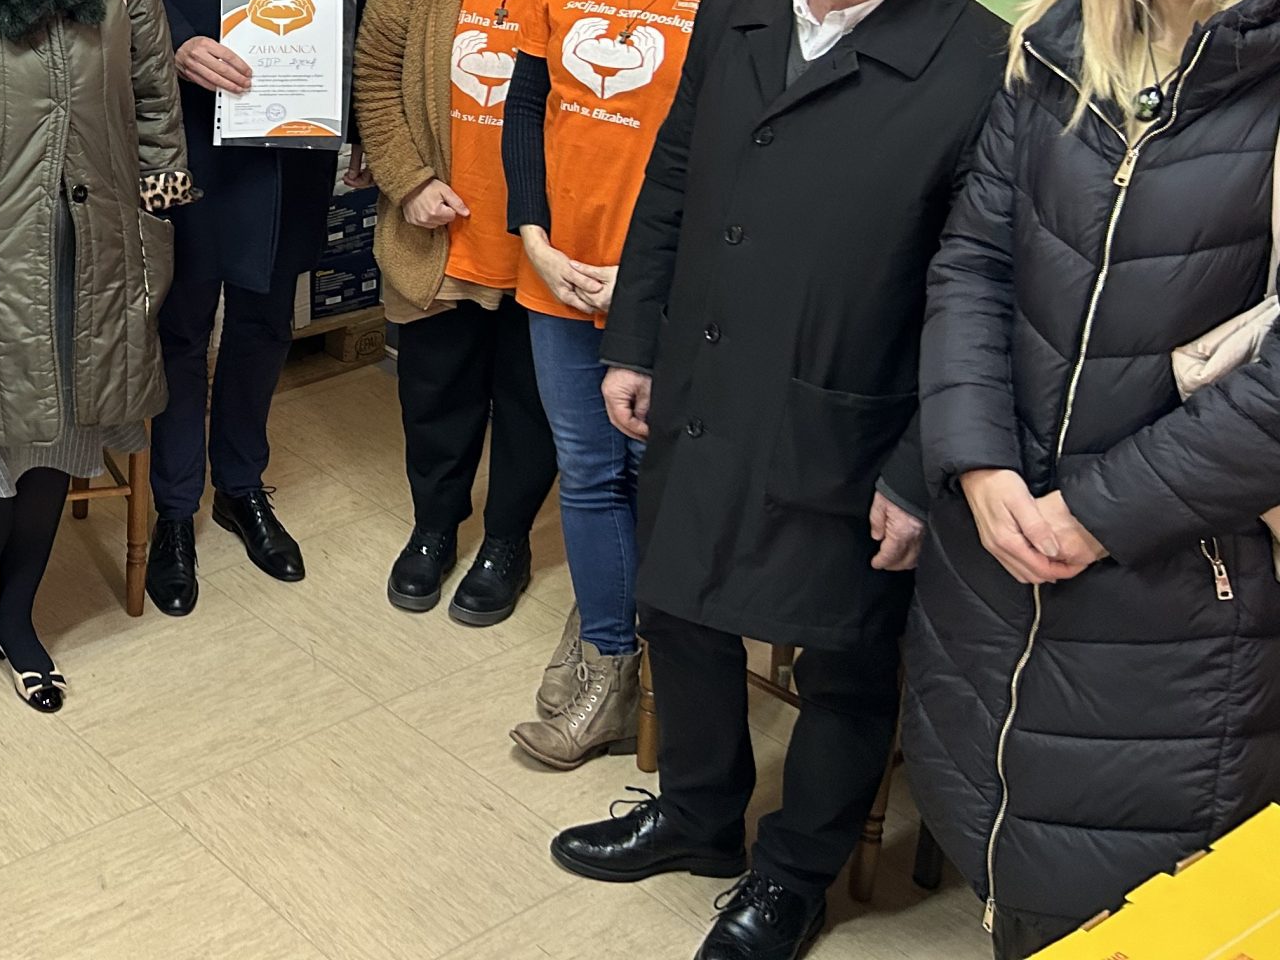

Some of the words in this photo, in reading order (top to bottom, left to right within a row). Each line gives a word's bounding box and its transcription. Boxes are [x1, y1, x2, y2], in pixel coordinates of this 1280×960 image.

[248, 44, 317, 54] ZAHVALNICA
[461, 114, 476, 122] sv.
[591, 108, 640, 129] Elizabete
